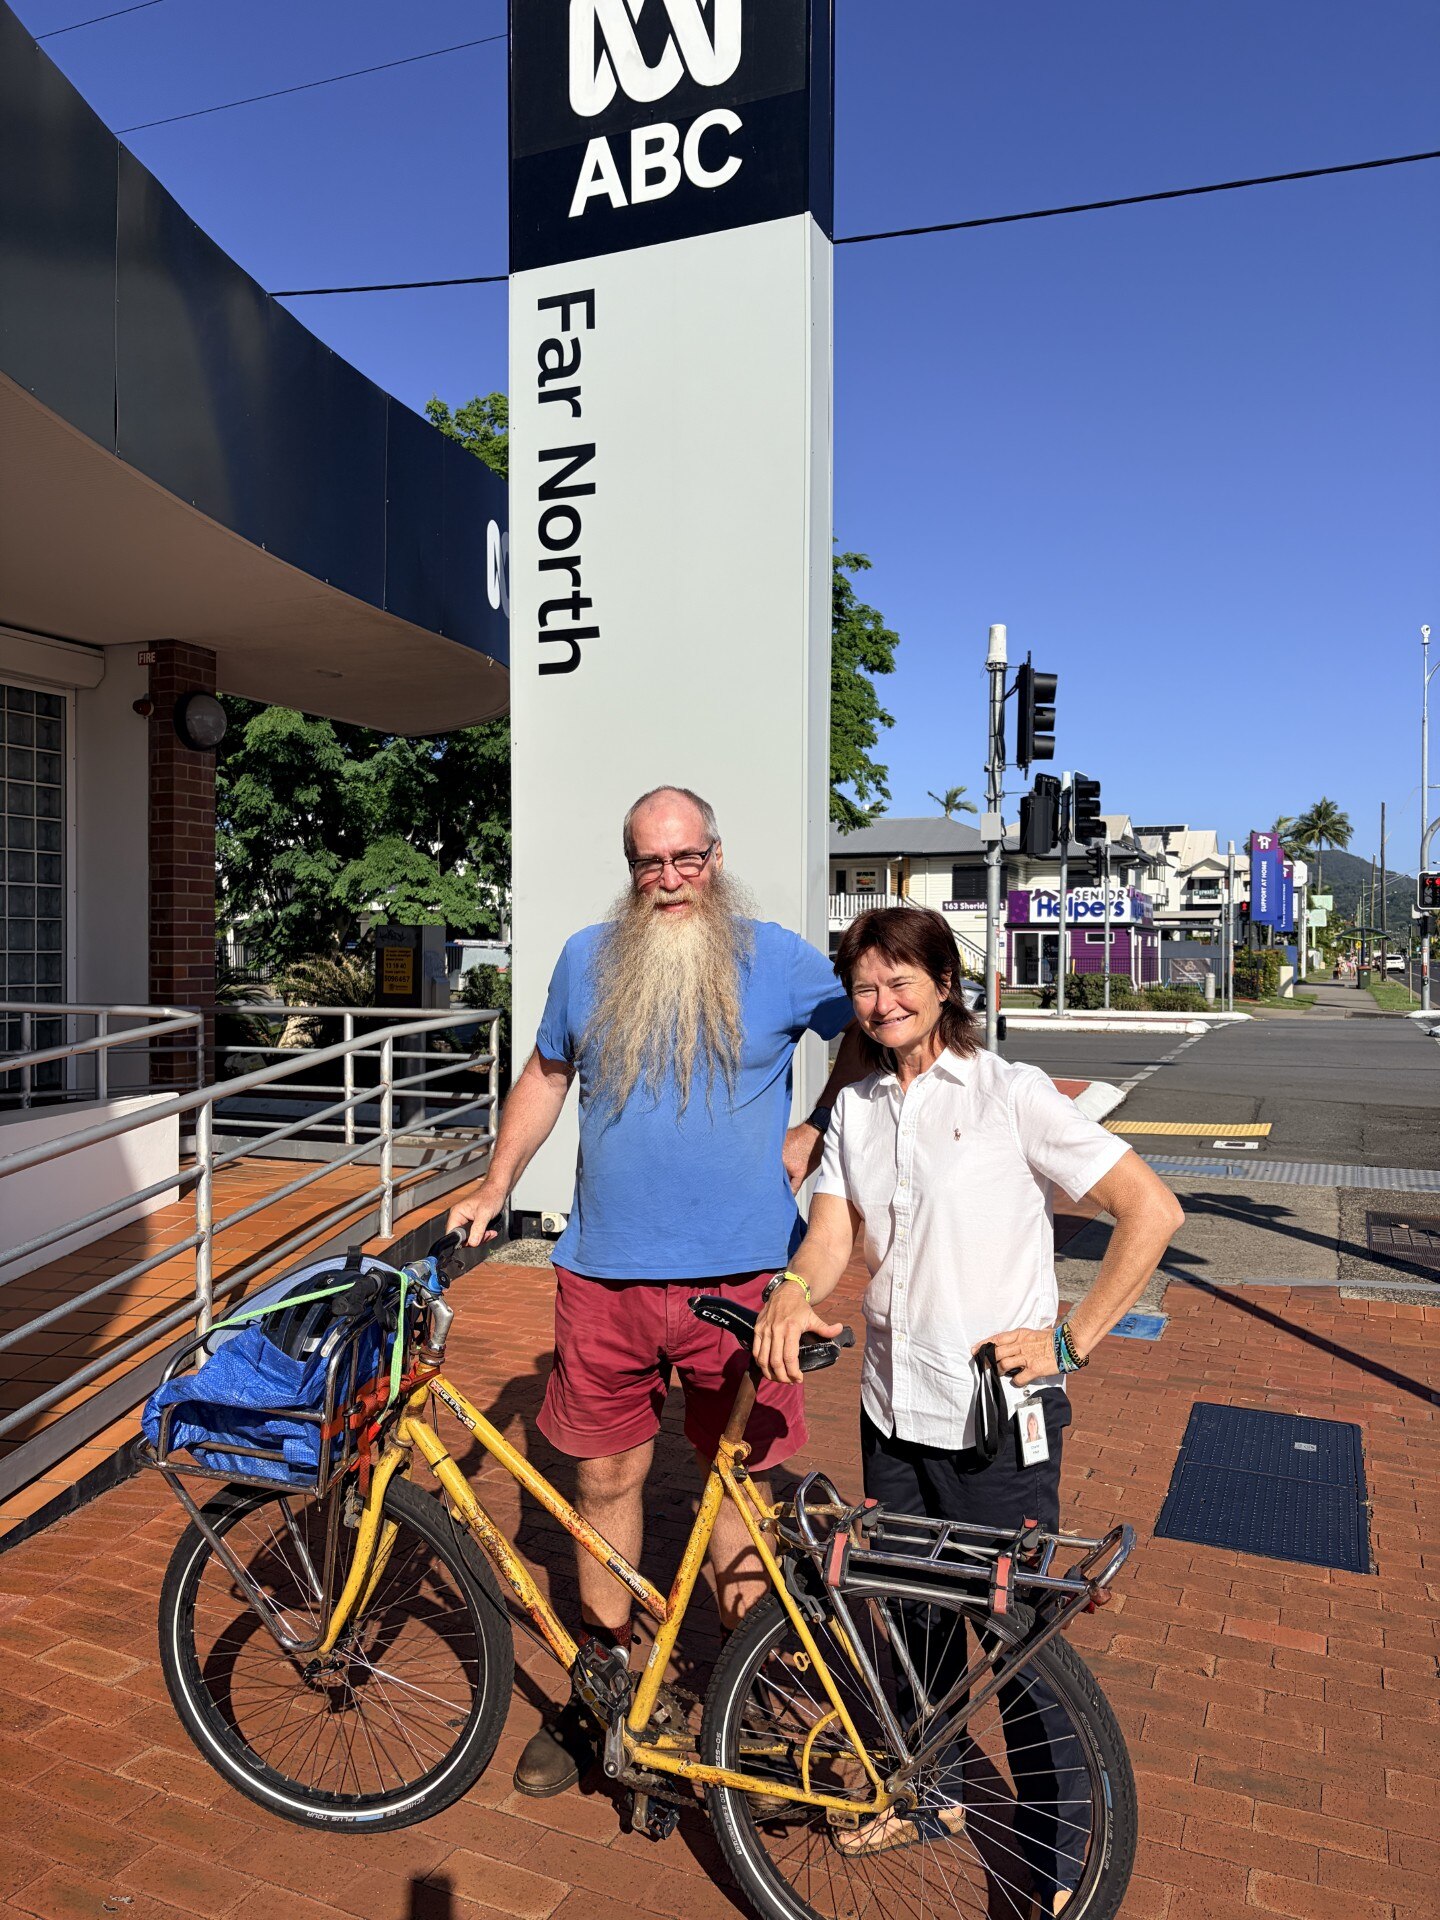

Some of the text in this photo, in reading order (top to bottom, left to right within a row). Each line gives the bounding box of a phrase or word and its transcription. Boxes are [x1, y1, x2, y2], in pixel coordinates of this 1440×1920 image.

[568, 108, 743, 218] ABC
[537, 288, 600, 676] Far North
[138, 651, 155, 663] FIRE
[1075, 890, 1124, 901] SENIOR
[944, 902, 959, 910] 163
[960, 901, 988, 910] Sherida
[1036, 896, 1125, 922] Helpers
[702, 1310, 730, 1326] CCM
[1079, 1711, 1106, 1768] SCHWALBE
[1103, 1843, 1112, 1871] TOUR
[386, 1795, 426, 1817] SCHWALBE
[306, 1811, 328, 1821] TOUR
